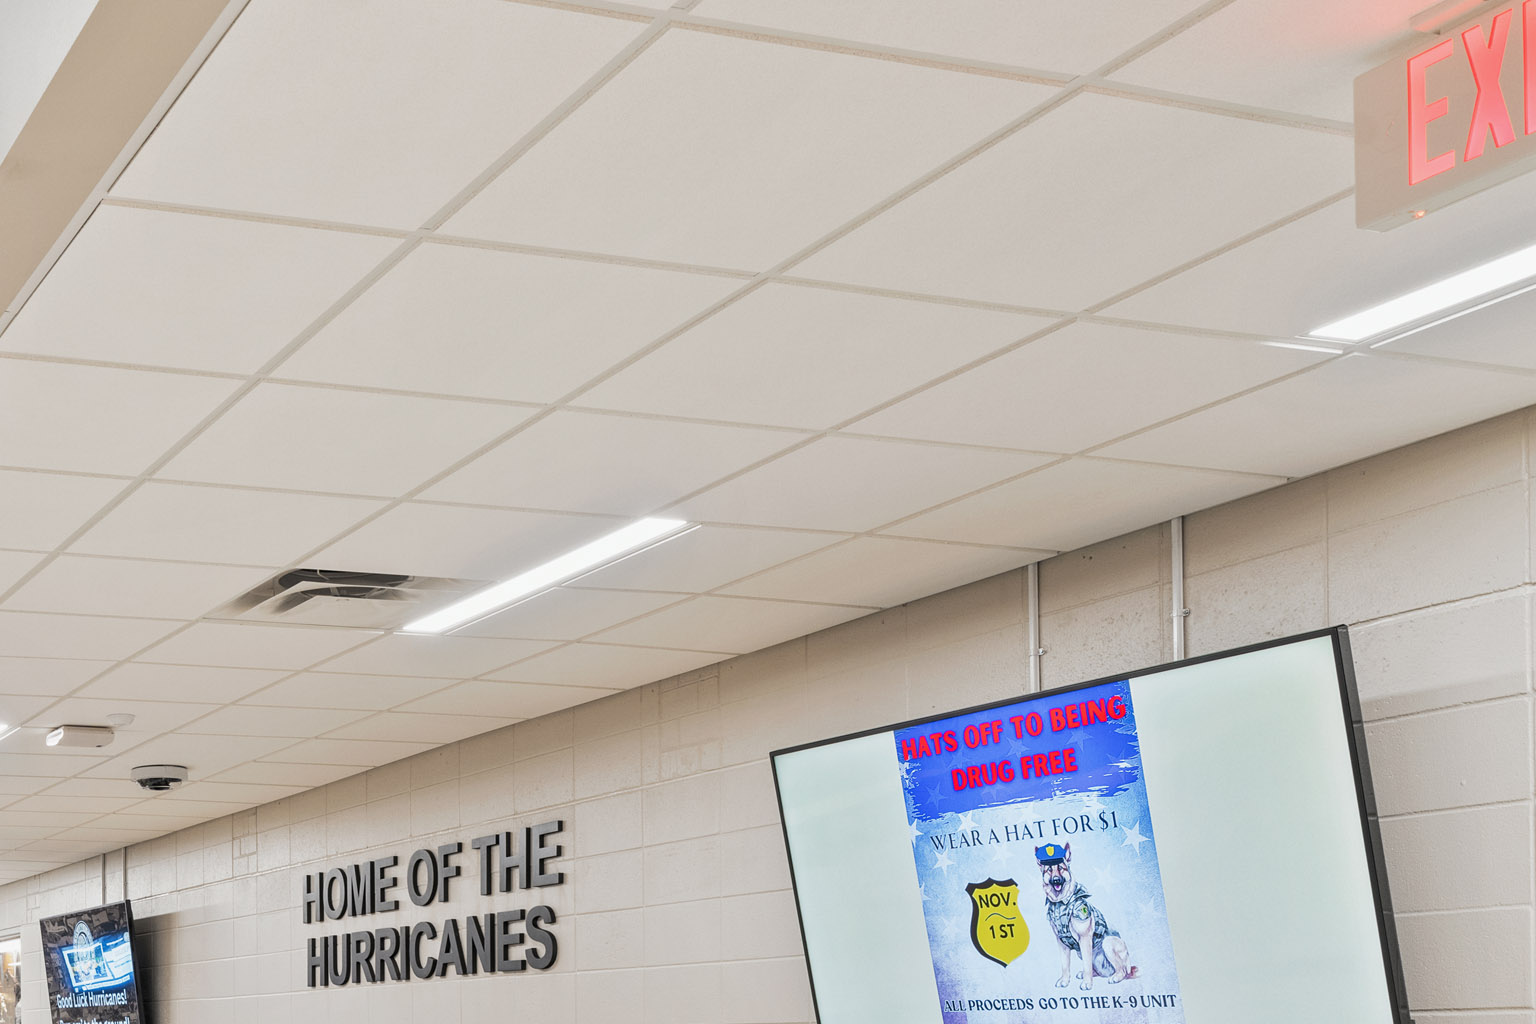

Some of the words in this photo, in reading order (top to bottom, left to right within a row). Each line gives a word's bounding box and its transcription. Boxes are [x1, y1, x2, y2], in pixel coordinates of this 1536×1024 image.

[901, 730, 958, 761] HATS
[963, 720, 1004, 749] OFF
[1009, 712, 1043, 739] TO
[1049, 695, 1127, 733] BEING
[951, 760, 1014, 791] DRUG
[1020, 748, 1078, 780] FREE
[930, 830, 984, 851] WEAR
[988, 828, 1000, 845] A
[1004, 820, 1045, 842] HAT
[1052, 814, 1094, 836] FOR
[1098, 810, 1118, 832] $1
[303, 855, 400, 924] HOME
[407, 842, 463, 906] OF
[471, 820, 564, 896] THE
[978, 892, 1016, 909] NOV.
[307, 905, 558, 988] HURRICANES
[56, 993, 74, 1008] Good
[74, 991, 89, 1008] Luck
[89, 989, 127, 1008] Hurricanes!
[944, 1000, 967, 1013] ALL
[968, 998, 1034, 1011] PROCEEDS
[1038, 998, 1058, 1010] GO
[1059, 997, 1079, 1010] TO
[1080, 996, 1111, 1009] THE
[1112, 996, 1138, 1009] K-9
[1139, 994, 1177, 1008] UNIT
